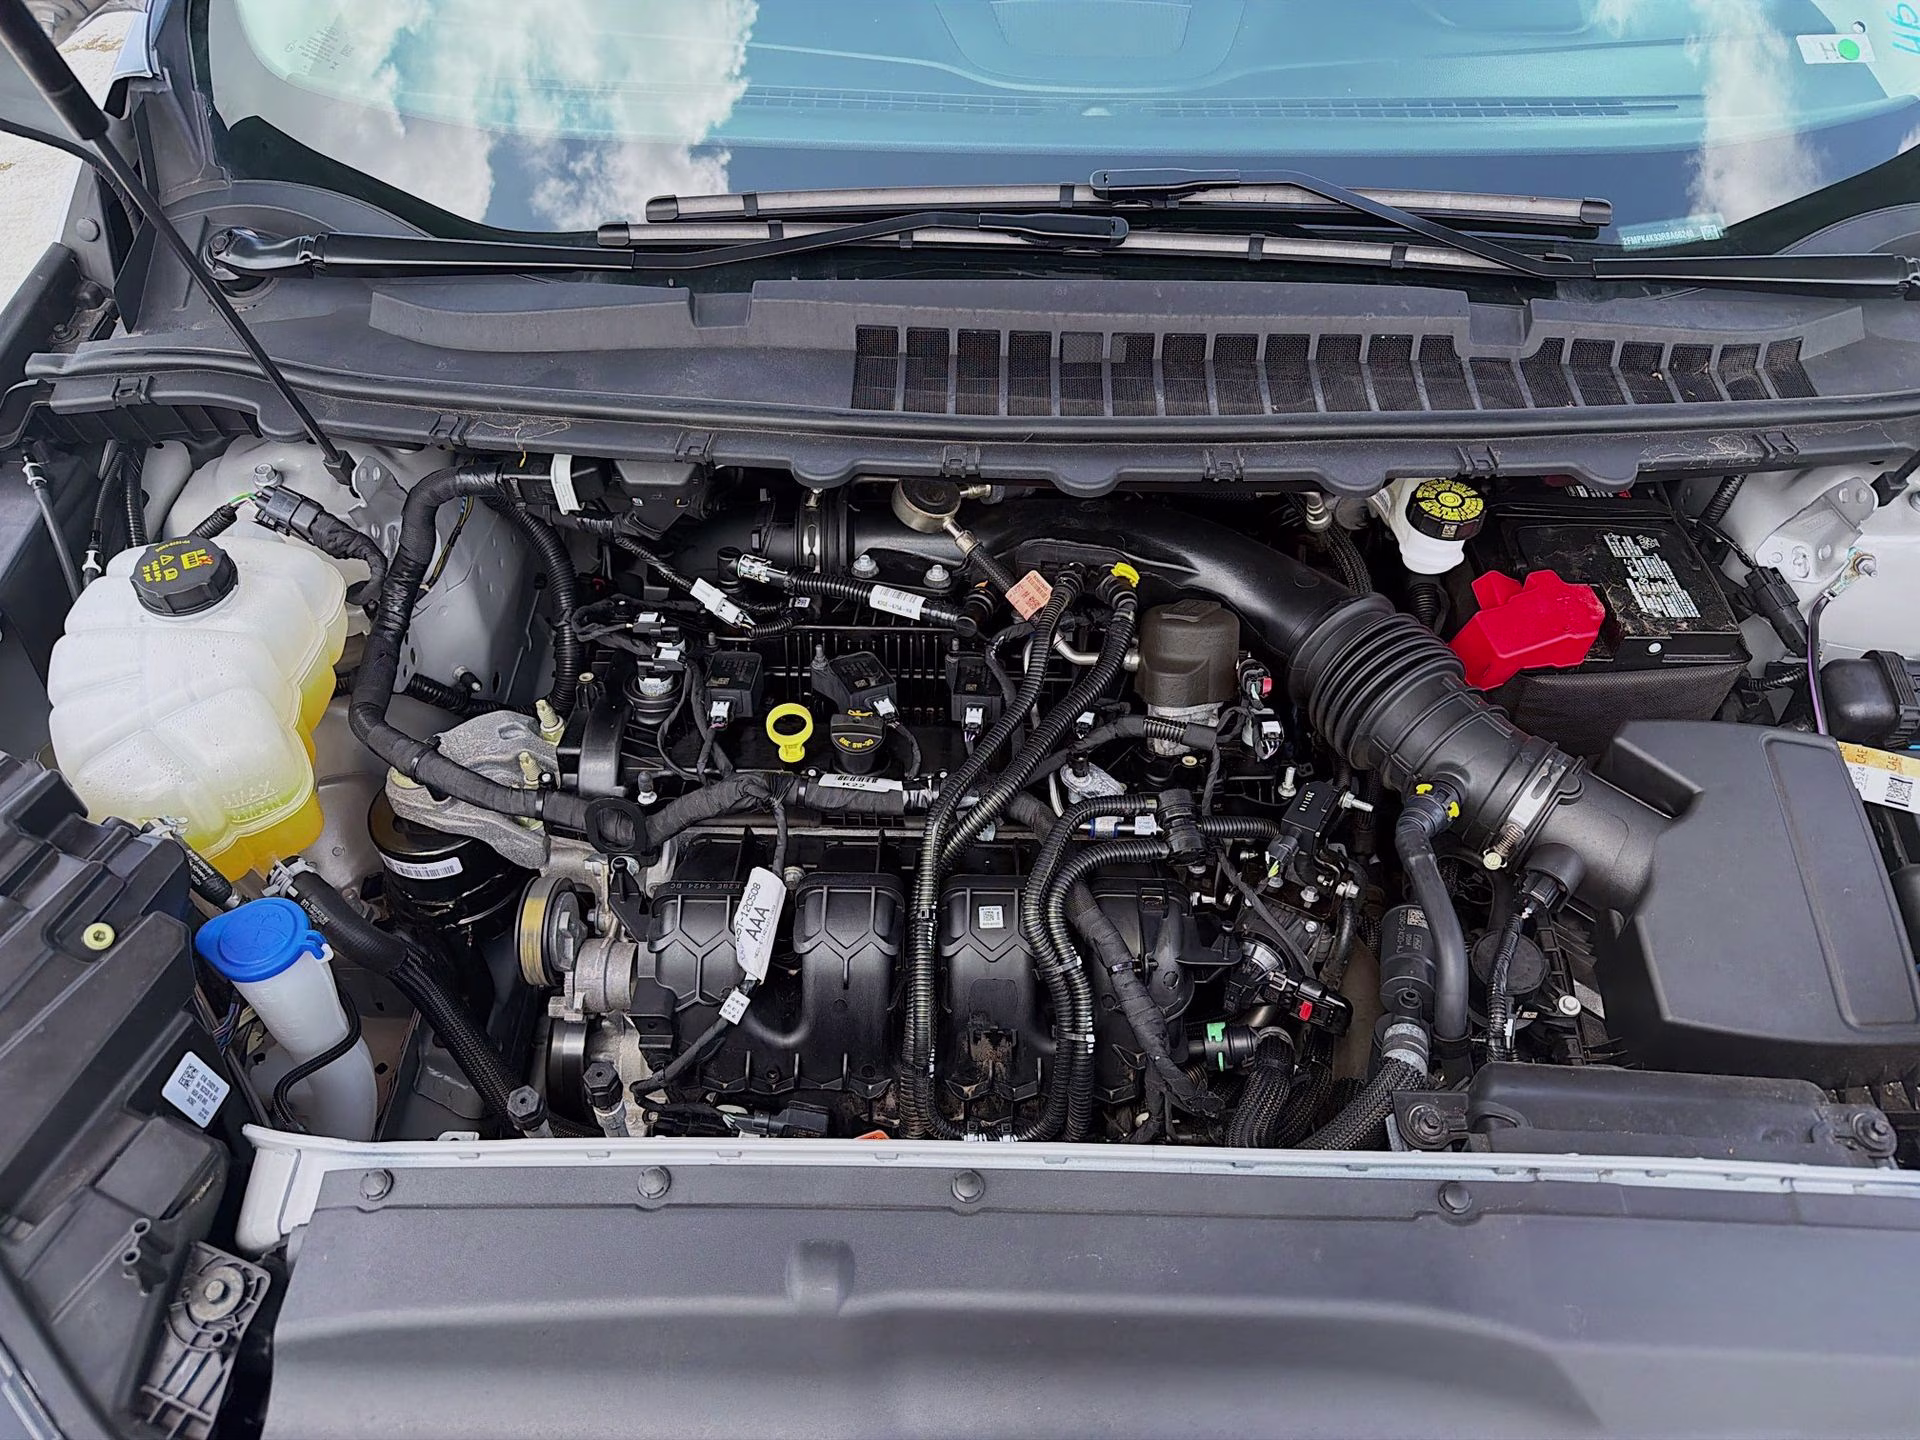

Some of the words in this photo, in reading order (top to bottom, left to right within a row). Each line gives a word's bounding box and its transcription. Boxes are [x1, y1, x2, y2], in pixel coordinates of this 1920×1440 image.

[1855, 748, 1868, 764] CAE
[1886, 755, 1898, 771] CAE
[745, 906, 770, 942] AAA
